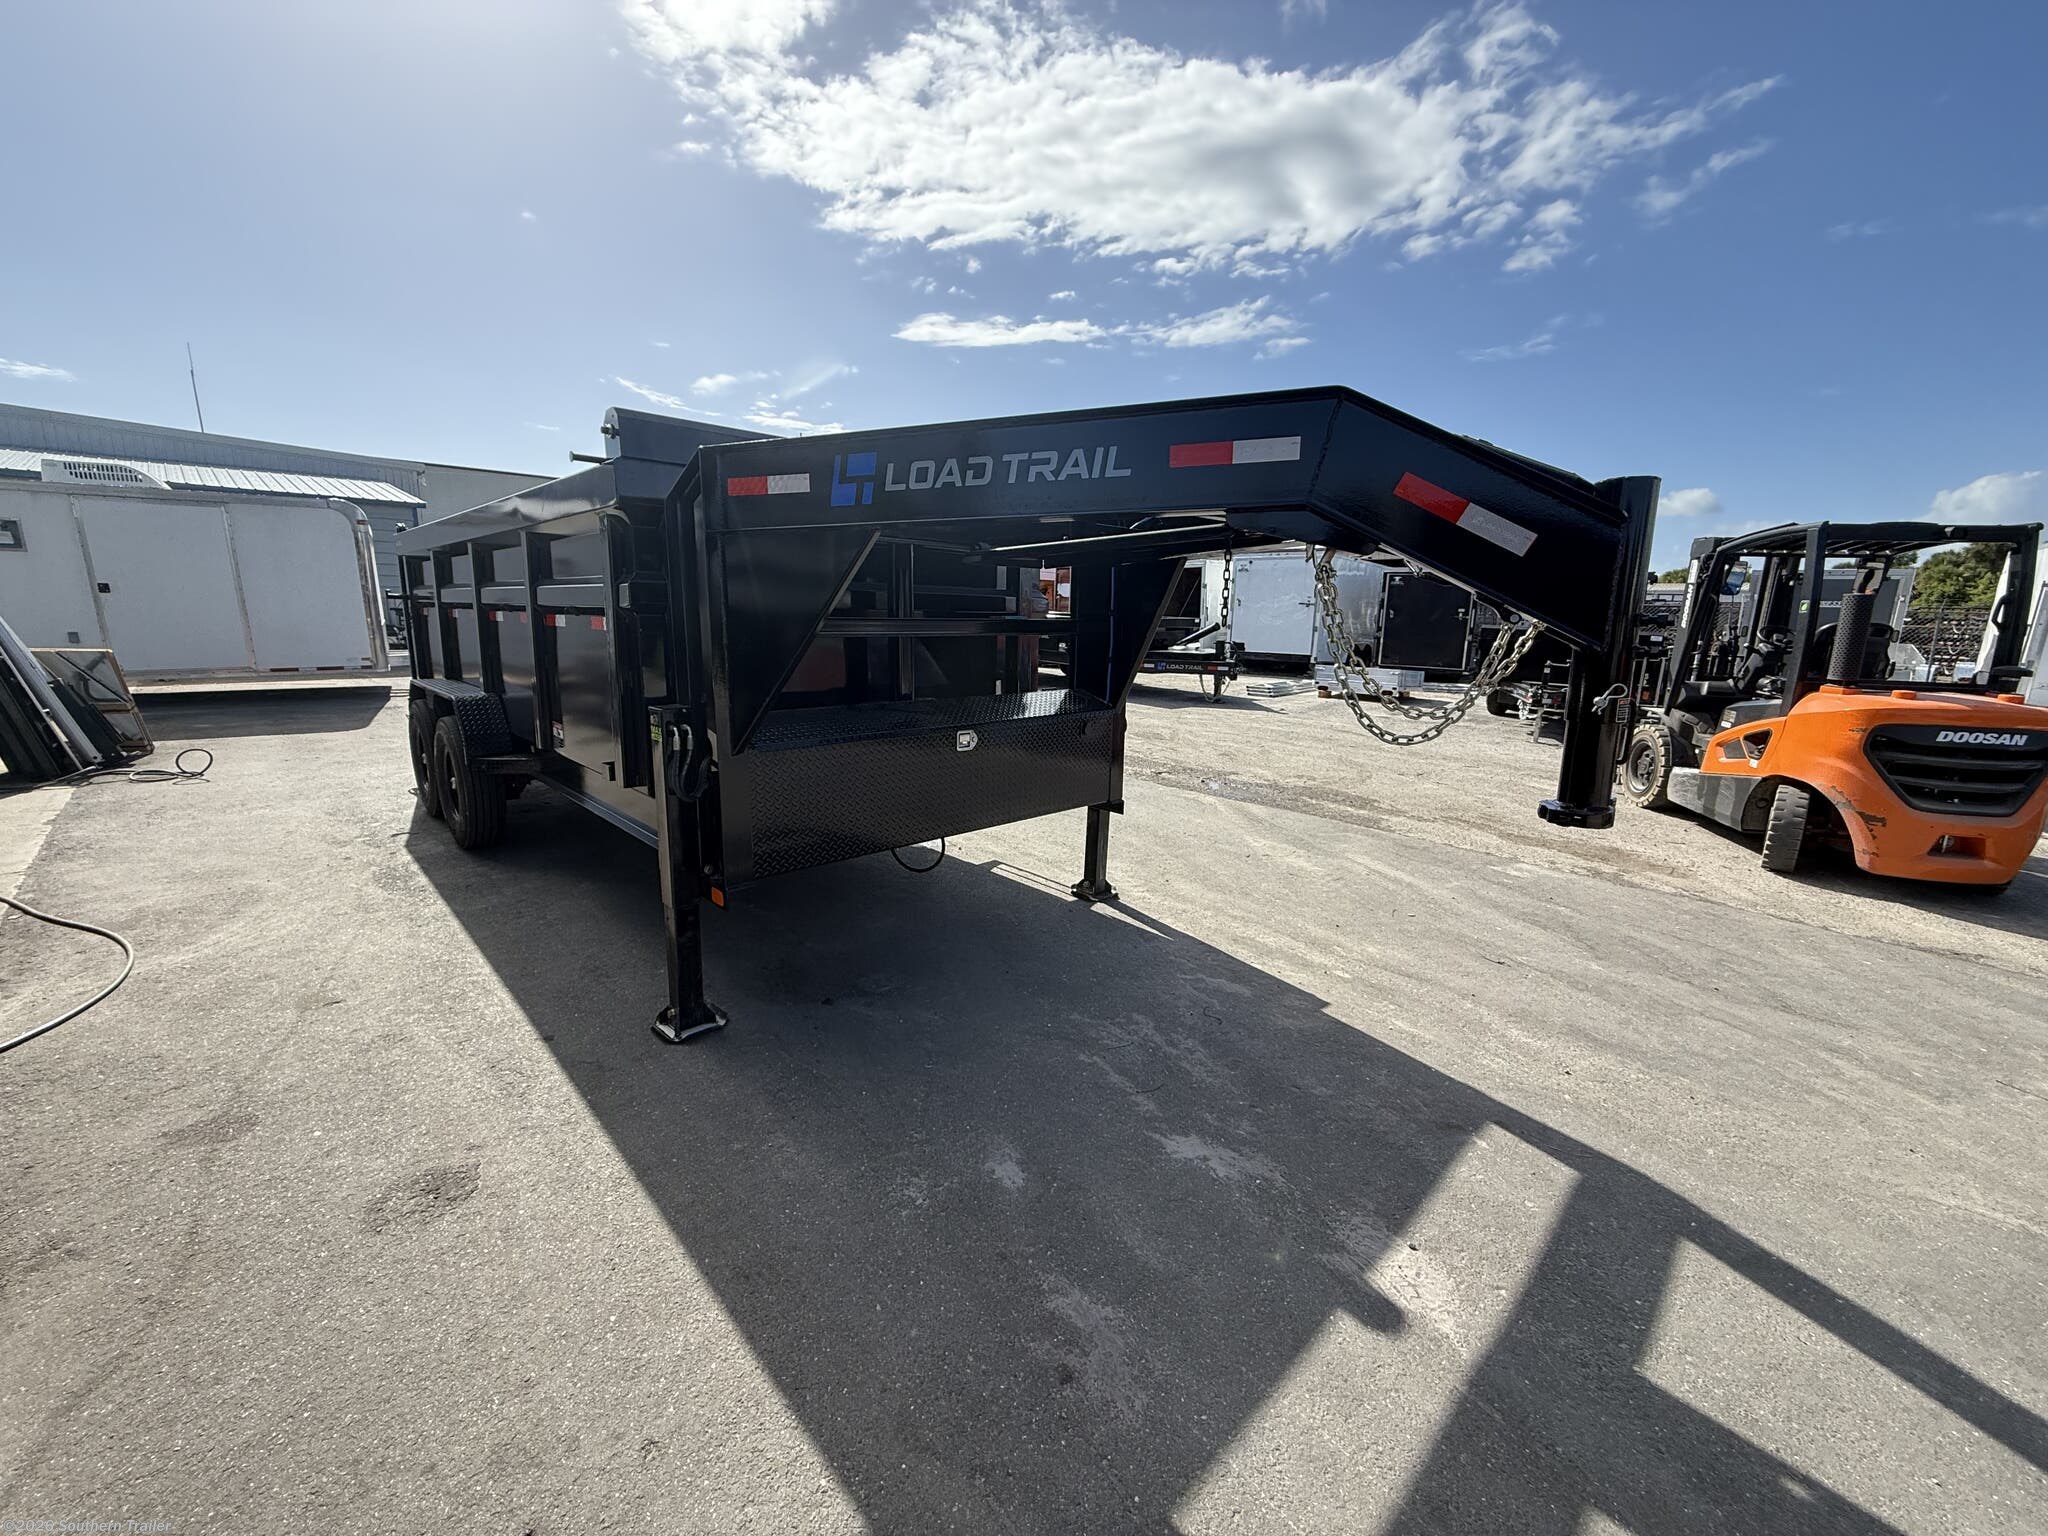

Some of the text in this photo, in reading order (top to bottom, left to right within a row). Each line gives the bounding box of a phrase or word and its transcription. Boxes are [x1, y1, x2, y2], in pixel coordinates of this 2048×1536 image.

[885, 455, 994, 492] LOAD
[1002, 446, 1132, 484] TRAIL
[1681, 583, 1694, 629] DOOSAN
[1936, 731, 2028, 746] DOOSAN
